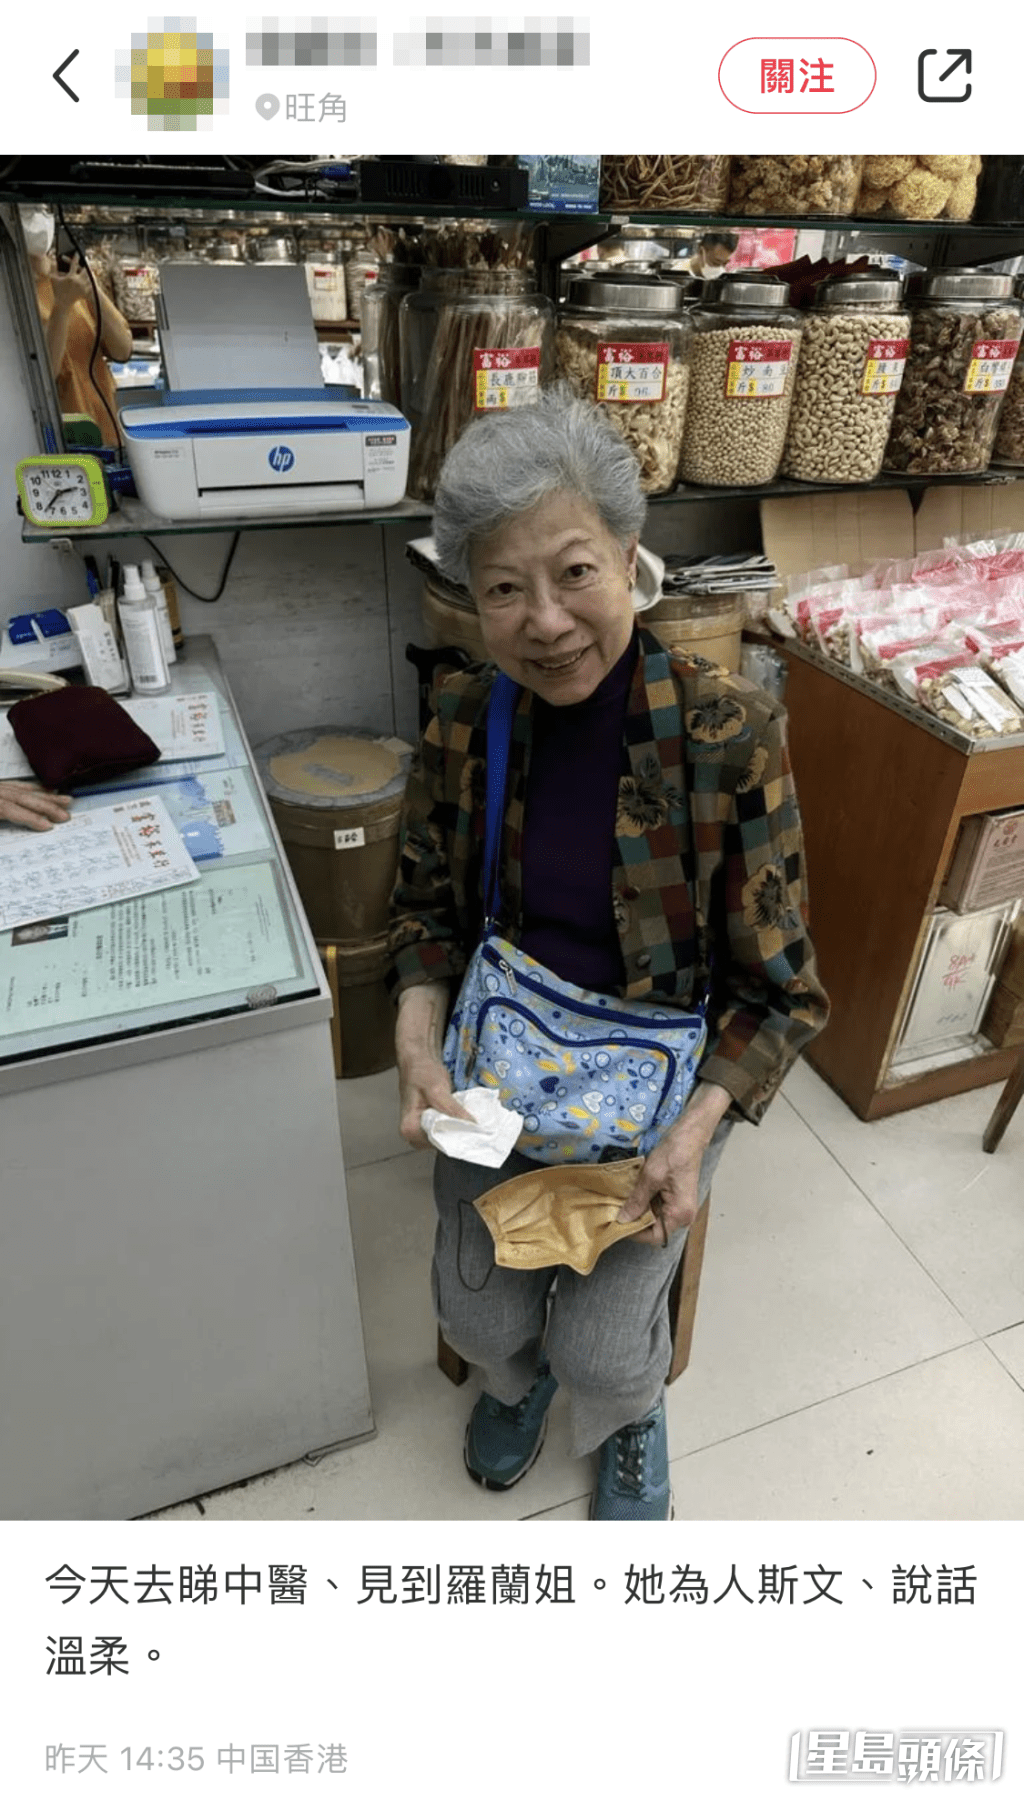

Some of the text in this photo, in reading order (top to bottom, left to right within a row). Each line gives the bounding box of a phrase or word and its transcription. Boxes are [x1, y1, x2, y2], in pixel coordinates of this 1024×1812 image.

[603, 347, 635, 363] 富裕
[734, 346, 764, 361] 富裕
[873, 344, 896, 358] 富裕
[977, 344, 1001, 359] 富裕
[480, 352, 511, 368] 富裕
[610, 366, 662, 380] 頂大百合
[271, 446, 292, 472] hp
[41, 469, 50, 479] 11
[51, 469, 62, 479] 12
[65, 469, 70, 479] 1
[30, 476, 41, 486] 10
[76, 475, 84, 484] 2
[32, 488, 40, 497] 9
[80, 487, 87, 497] 3
[36, 501, 43, 511] 8
[82, 500, 89, 509] 4
[49, 506, 56, 515] 7
[60, 506, 67, 516] 6
[71, 506, 78, 515] 5
